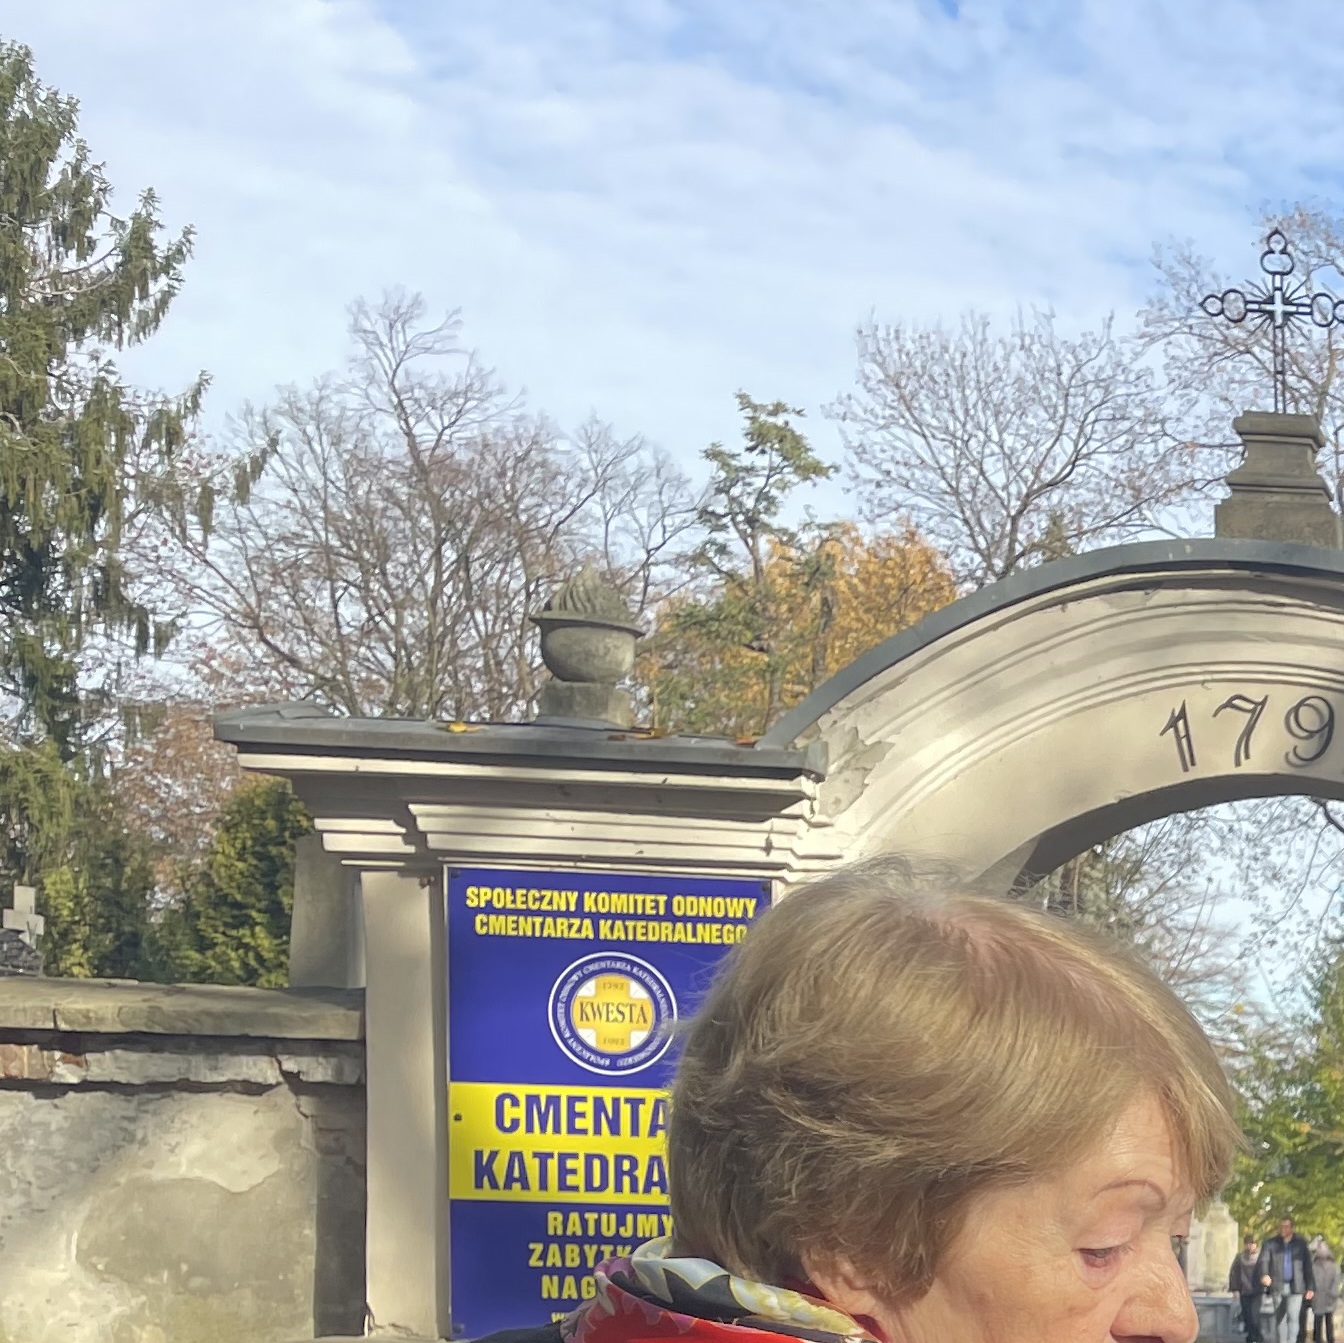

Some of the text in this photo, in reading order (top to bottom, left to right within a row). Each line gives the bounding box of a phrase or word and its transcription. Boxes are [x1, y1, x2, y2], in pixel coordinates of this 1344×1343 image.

[466, 886, 757, 918] SPOŁECZNY KOMITET ODNOWY
[475, 915, 747, 945] CMENTARZA KATEDRALNEGO
[579, 1001, 648, 1025] KWESTA
[494, 1092, 670, 1137] CMENTA
[473, 1149, 670, 1195] KATEDRA
[547, 1211, 674, 1238] RATUJMY
